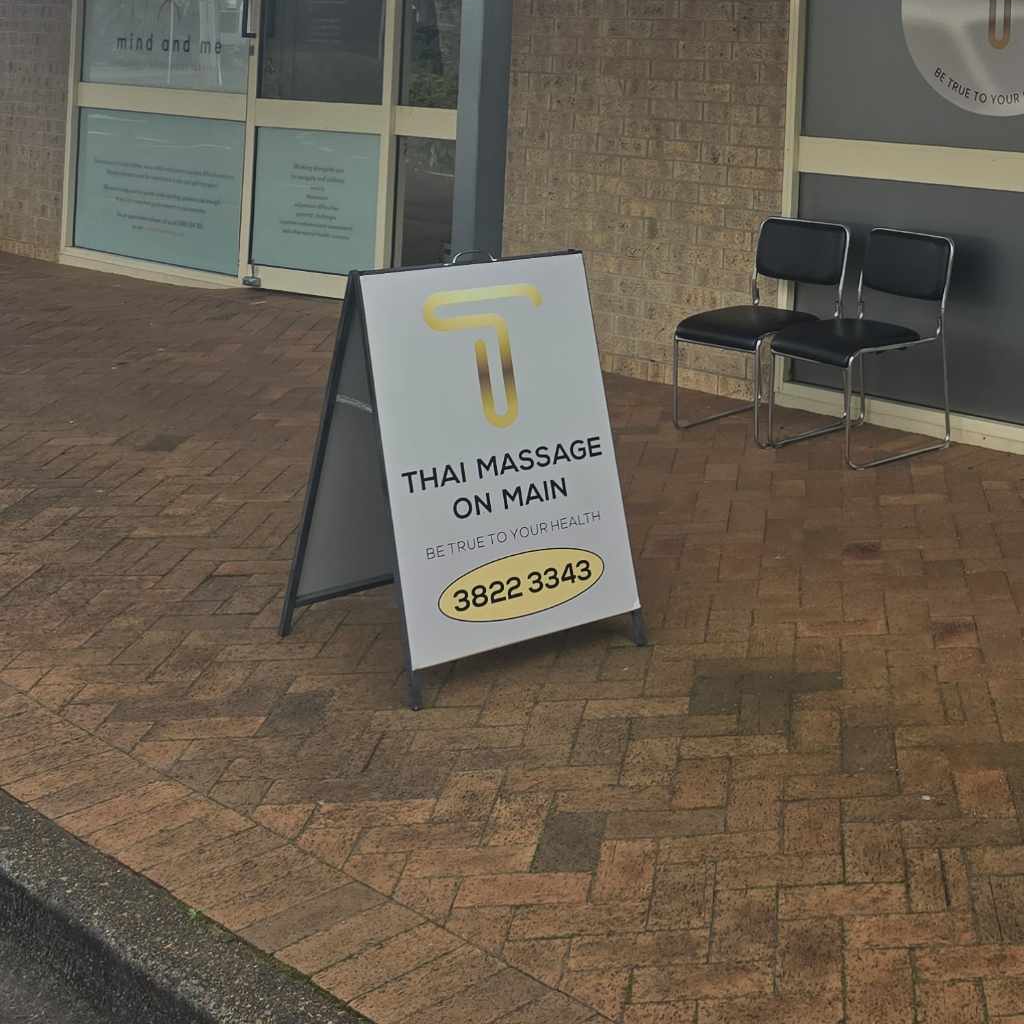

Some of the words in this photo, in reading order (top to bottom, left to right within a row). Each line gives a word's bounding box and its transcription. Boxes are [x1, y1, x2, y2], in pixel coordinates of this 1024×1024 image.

[116, 32, 154, 52] mind
[161, 33, 192, 53] and
[200, 40, 223, 55] me
[934, 66, 945, 83] BE
[946, 75, 972, 100] TRUE
[973, 89, 988, 104] TO
[990, 91, 1020, 105] YOUR
[401, 461, 466, 494] THAI
[476, 436, 603, 481] MASSAGE
[452, 492, 493, 520] ON
[502, 477, 569, 511] MAIN
[425, 544, 445, 560] BE
[446, 535, 486, 557] TRUE
[487, 530, 508, 546] TO
[508, 521, 549, 542] YOUR
[550, 510, 602, 533] HEALTH
[452, 576, 524, 613] 3822
[527, 558, 593, 595] 3343
